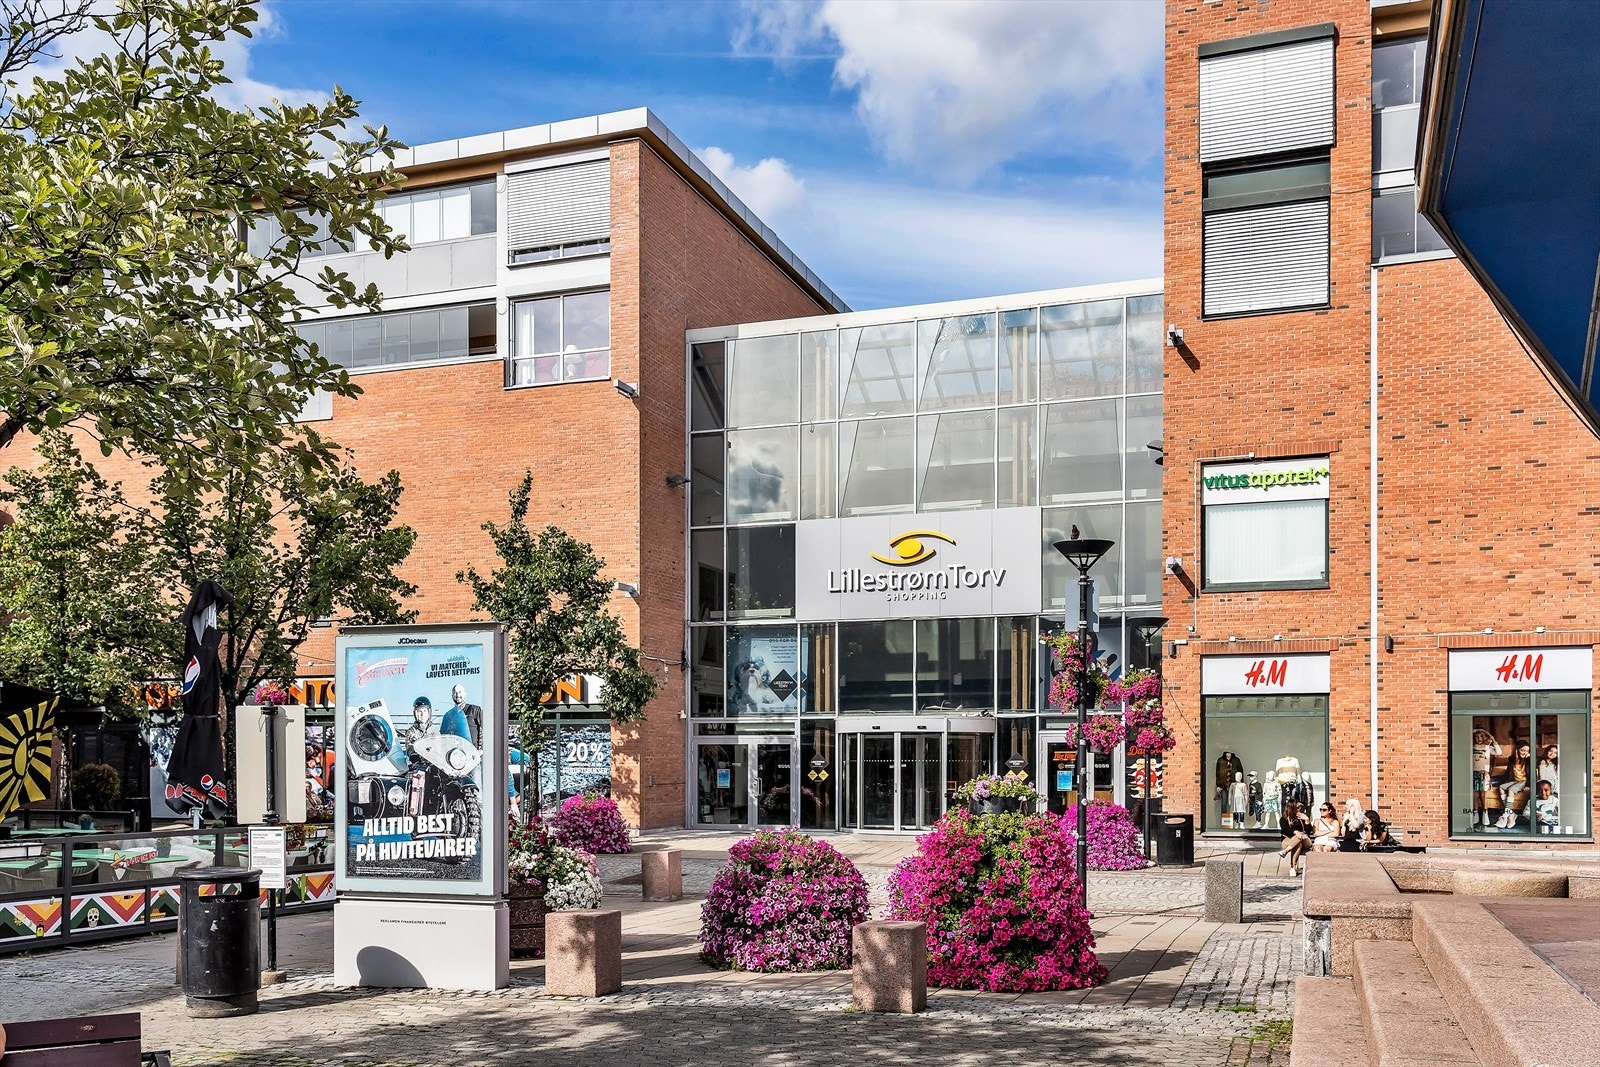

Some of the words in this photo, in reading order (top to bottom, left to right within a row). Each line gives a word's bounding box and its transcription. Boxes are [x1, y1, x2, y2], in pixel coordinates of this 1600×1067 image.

[1203, 468, 1318, 489] vitusapotek
[827, 567, 946, 593] Lillestrøm
[947, 563, 1006, 588] Torv
[886, 591, 947, 601] SHOPPING
[426, 670, 451, 678] LAVESTE
[452, 667, 480, 676] NETTPRIS
[439, 661, 467, 671] MATCHER
[1245, 660, 1288, 687] H&M
[1496, 654, 1543, 683] H&M
[566, 742, 604, 762] 20%
[363, 816, 415, 837] ALLTID
[417, 813, 455, 834] BEST
[356, 838, 376, 861] PÅ
[379, 838, 477, 860] HVITEVARER
